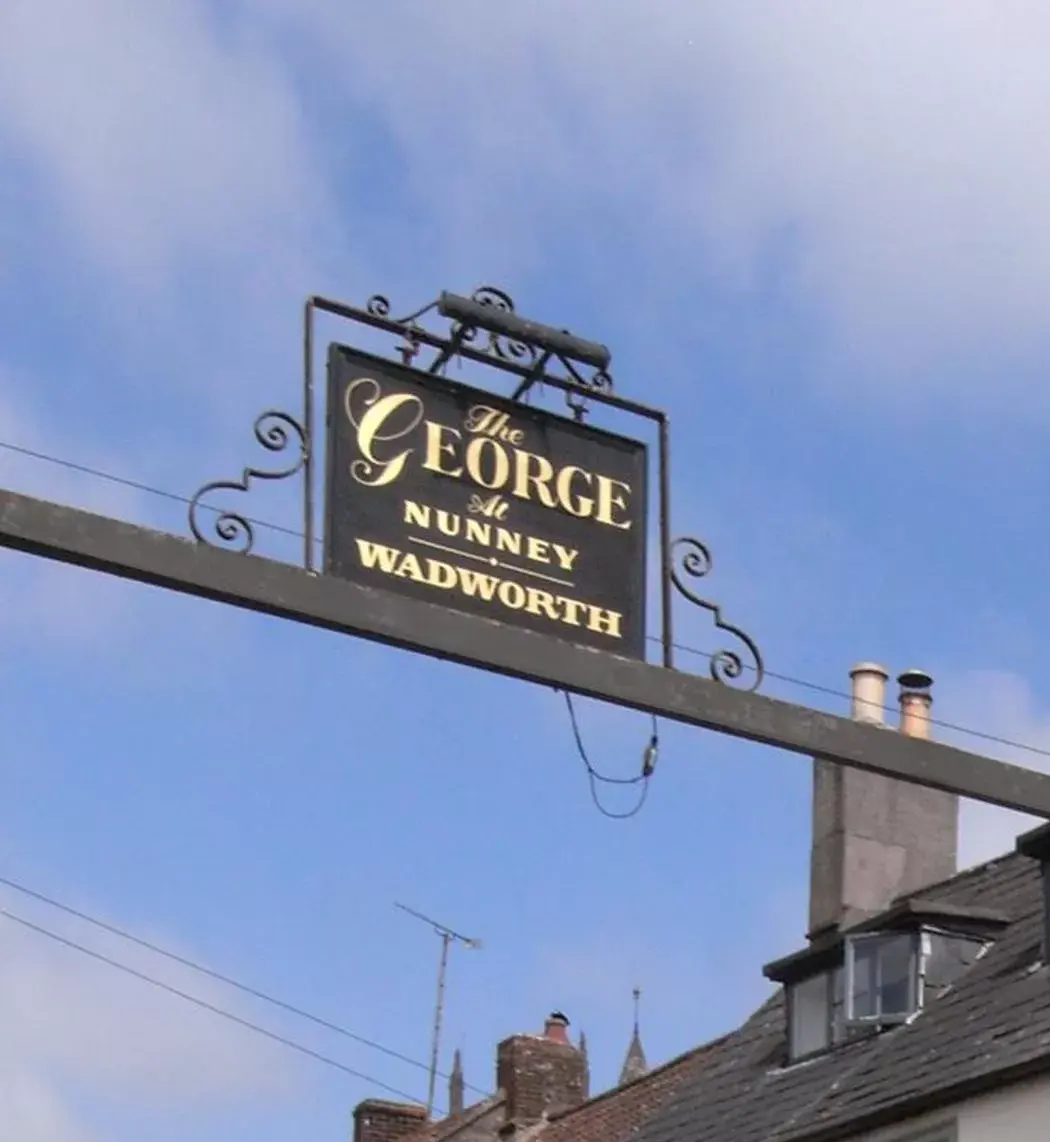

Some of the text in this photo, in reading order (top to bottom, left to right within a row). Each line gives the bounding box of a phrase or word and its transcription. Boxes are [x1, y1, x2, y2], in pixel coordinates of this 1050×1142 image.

[345, 378, 632, 530] GEORGE
[465, 404, 524, 447] The
[404, 500, 579, 572] NUNNEY
[468, 495, 509, 521] At
[355, 538, 623, 639] WADWORTH
